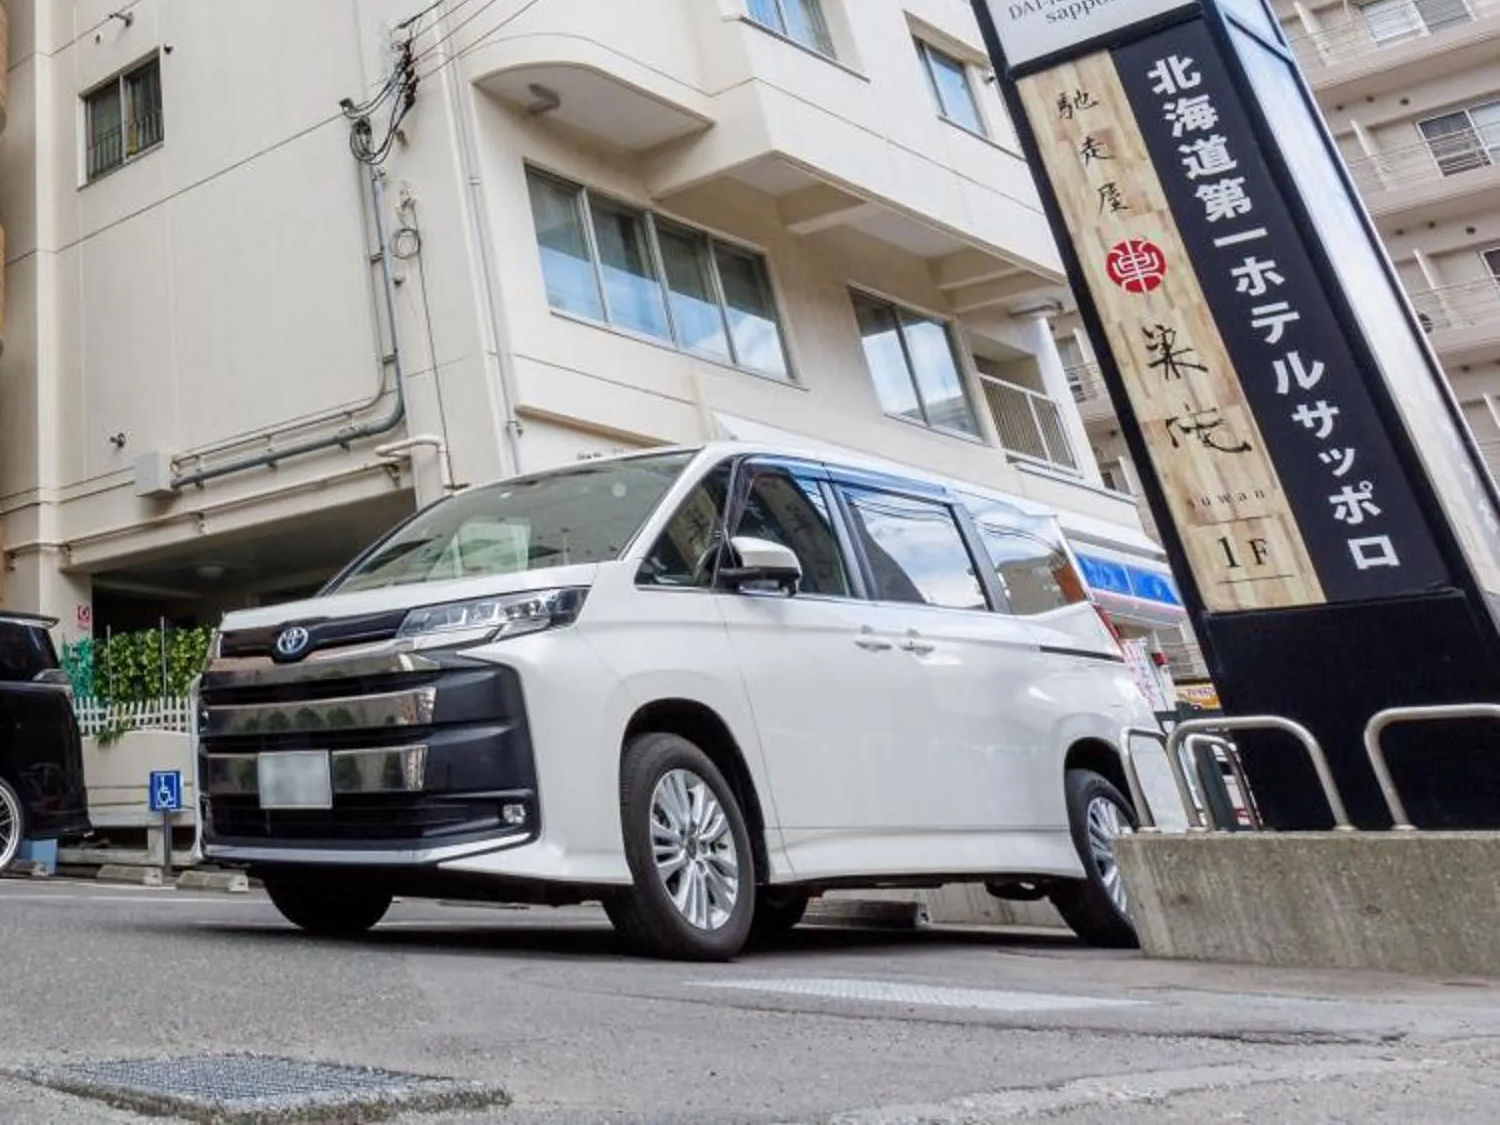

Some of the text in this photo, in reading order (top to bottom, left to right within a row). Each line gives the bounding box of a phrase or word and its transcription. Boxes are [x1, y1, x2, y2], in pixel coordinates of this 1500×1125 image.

[1147, 55, 1400, 570] 北海道第一ホテルサッポロ
